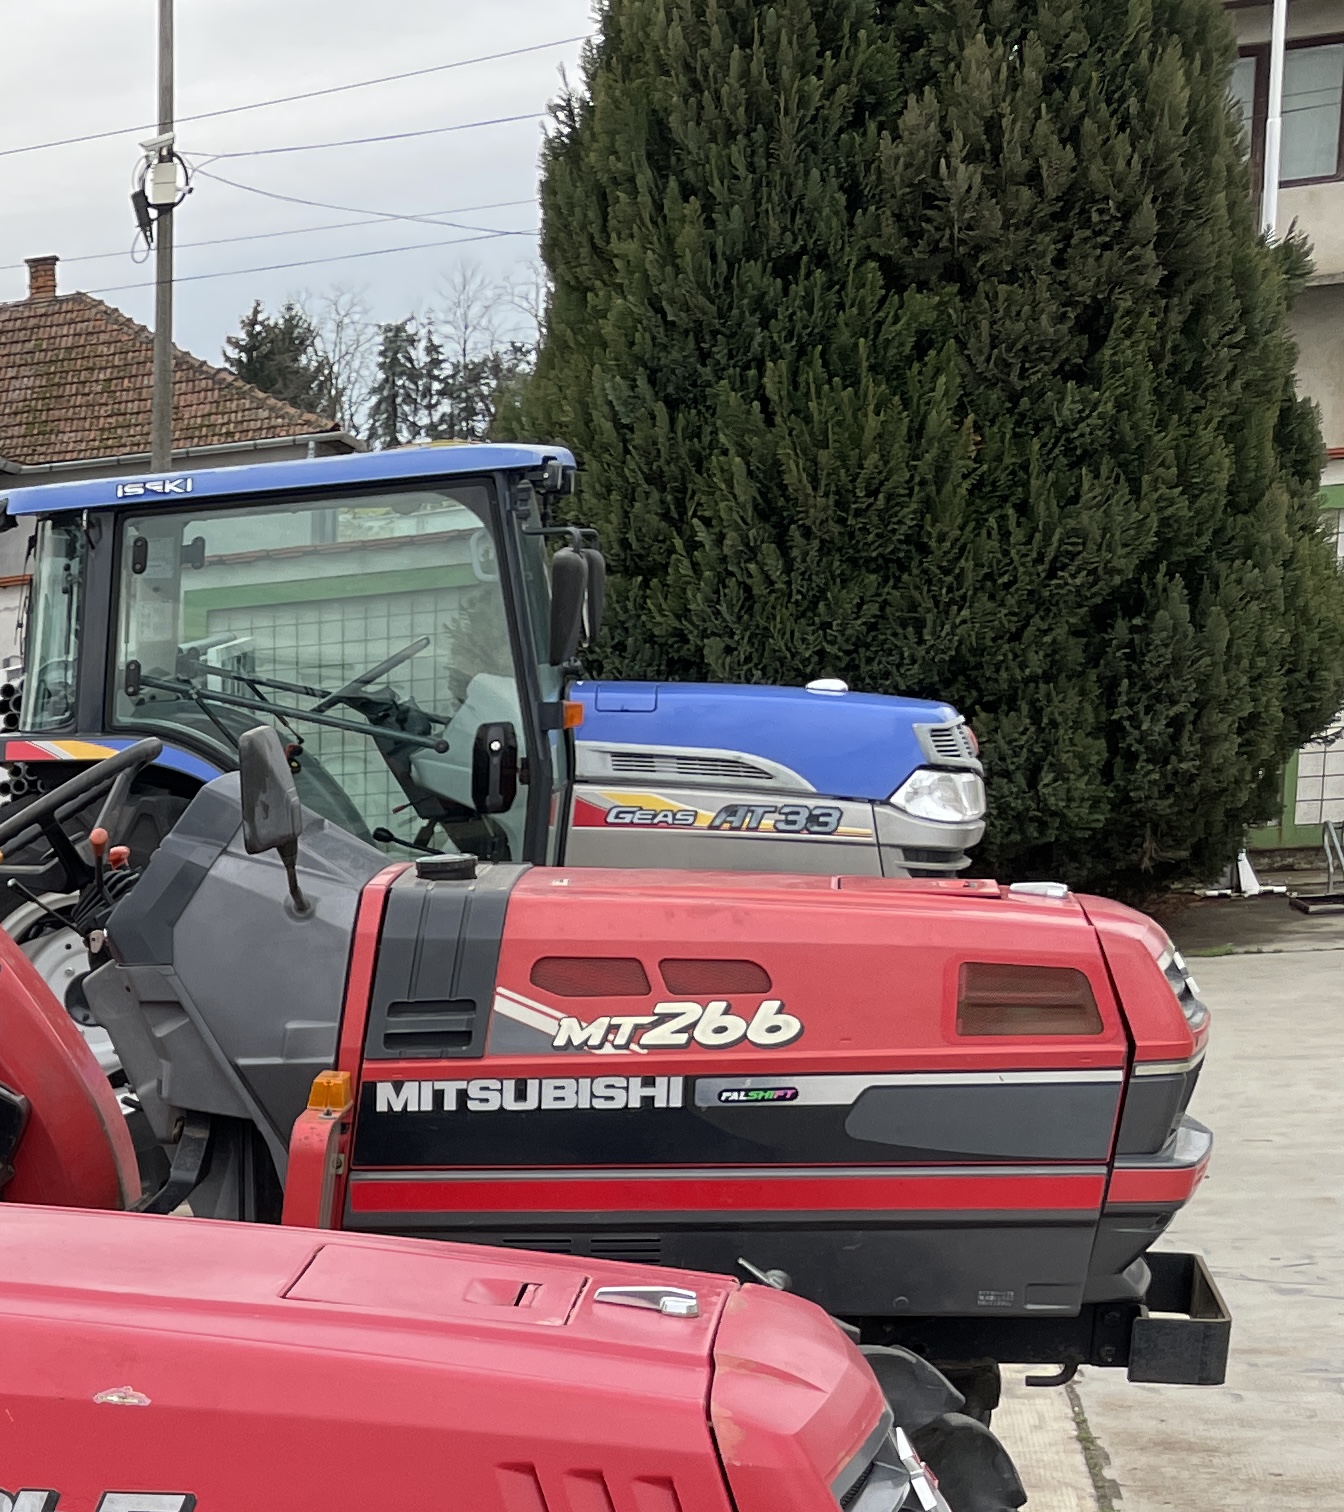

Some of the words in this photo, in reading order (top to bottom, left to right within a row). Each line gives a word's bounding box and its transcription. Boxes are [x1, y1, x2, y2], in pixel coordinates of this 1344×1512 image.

[116, 477, 194, 498] ISEKI
[552, 999, 805, 1051] MT266
[375, 1075, 686, 1113] MITSUBISHI
